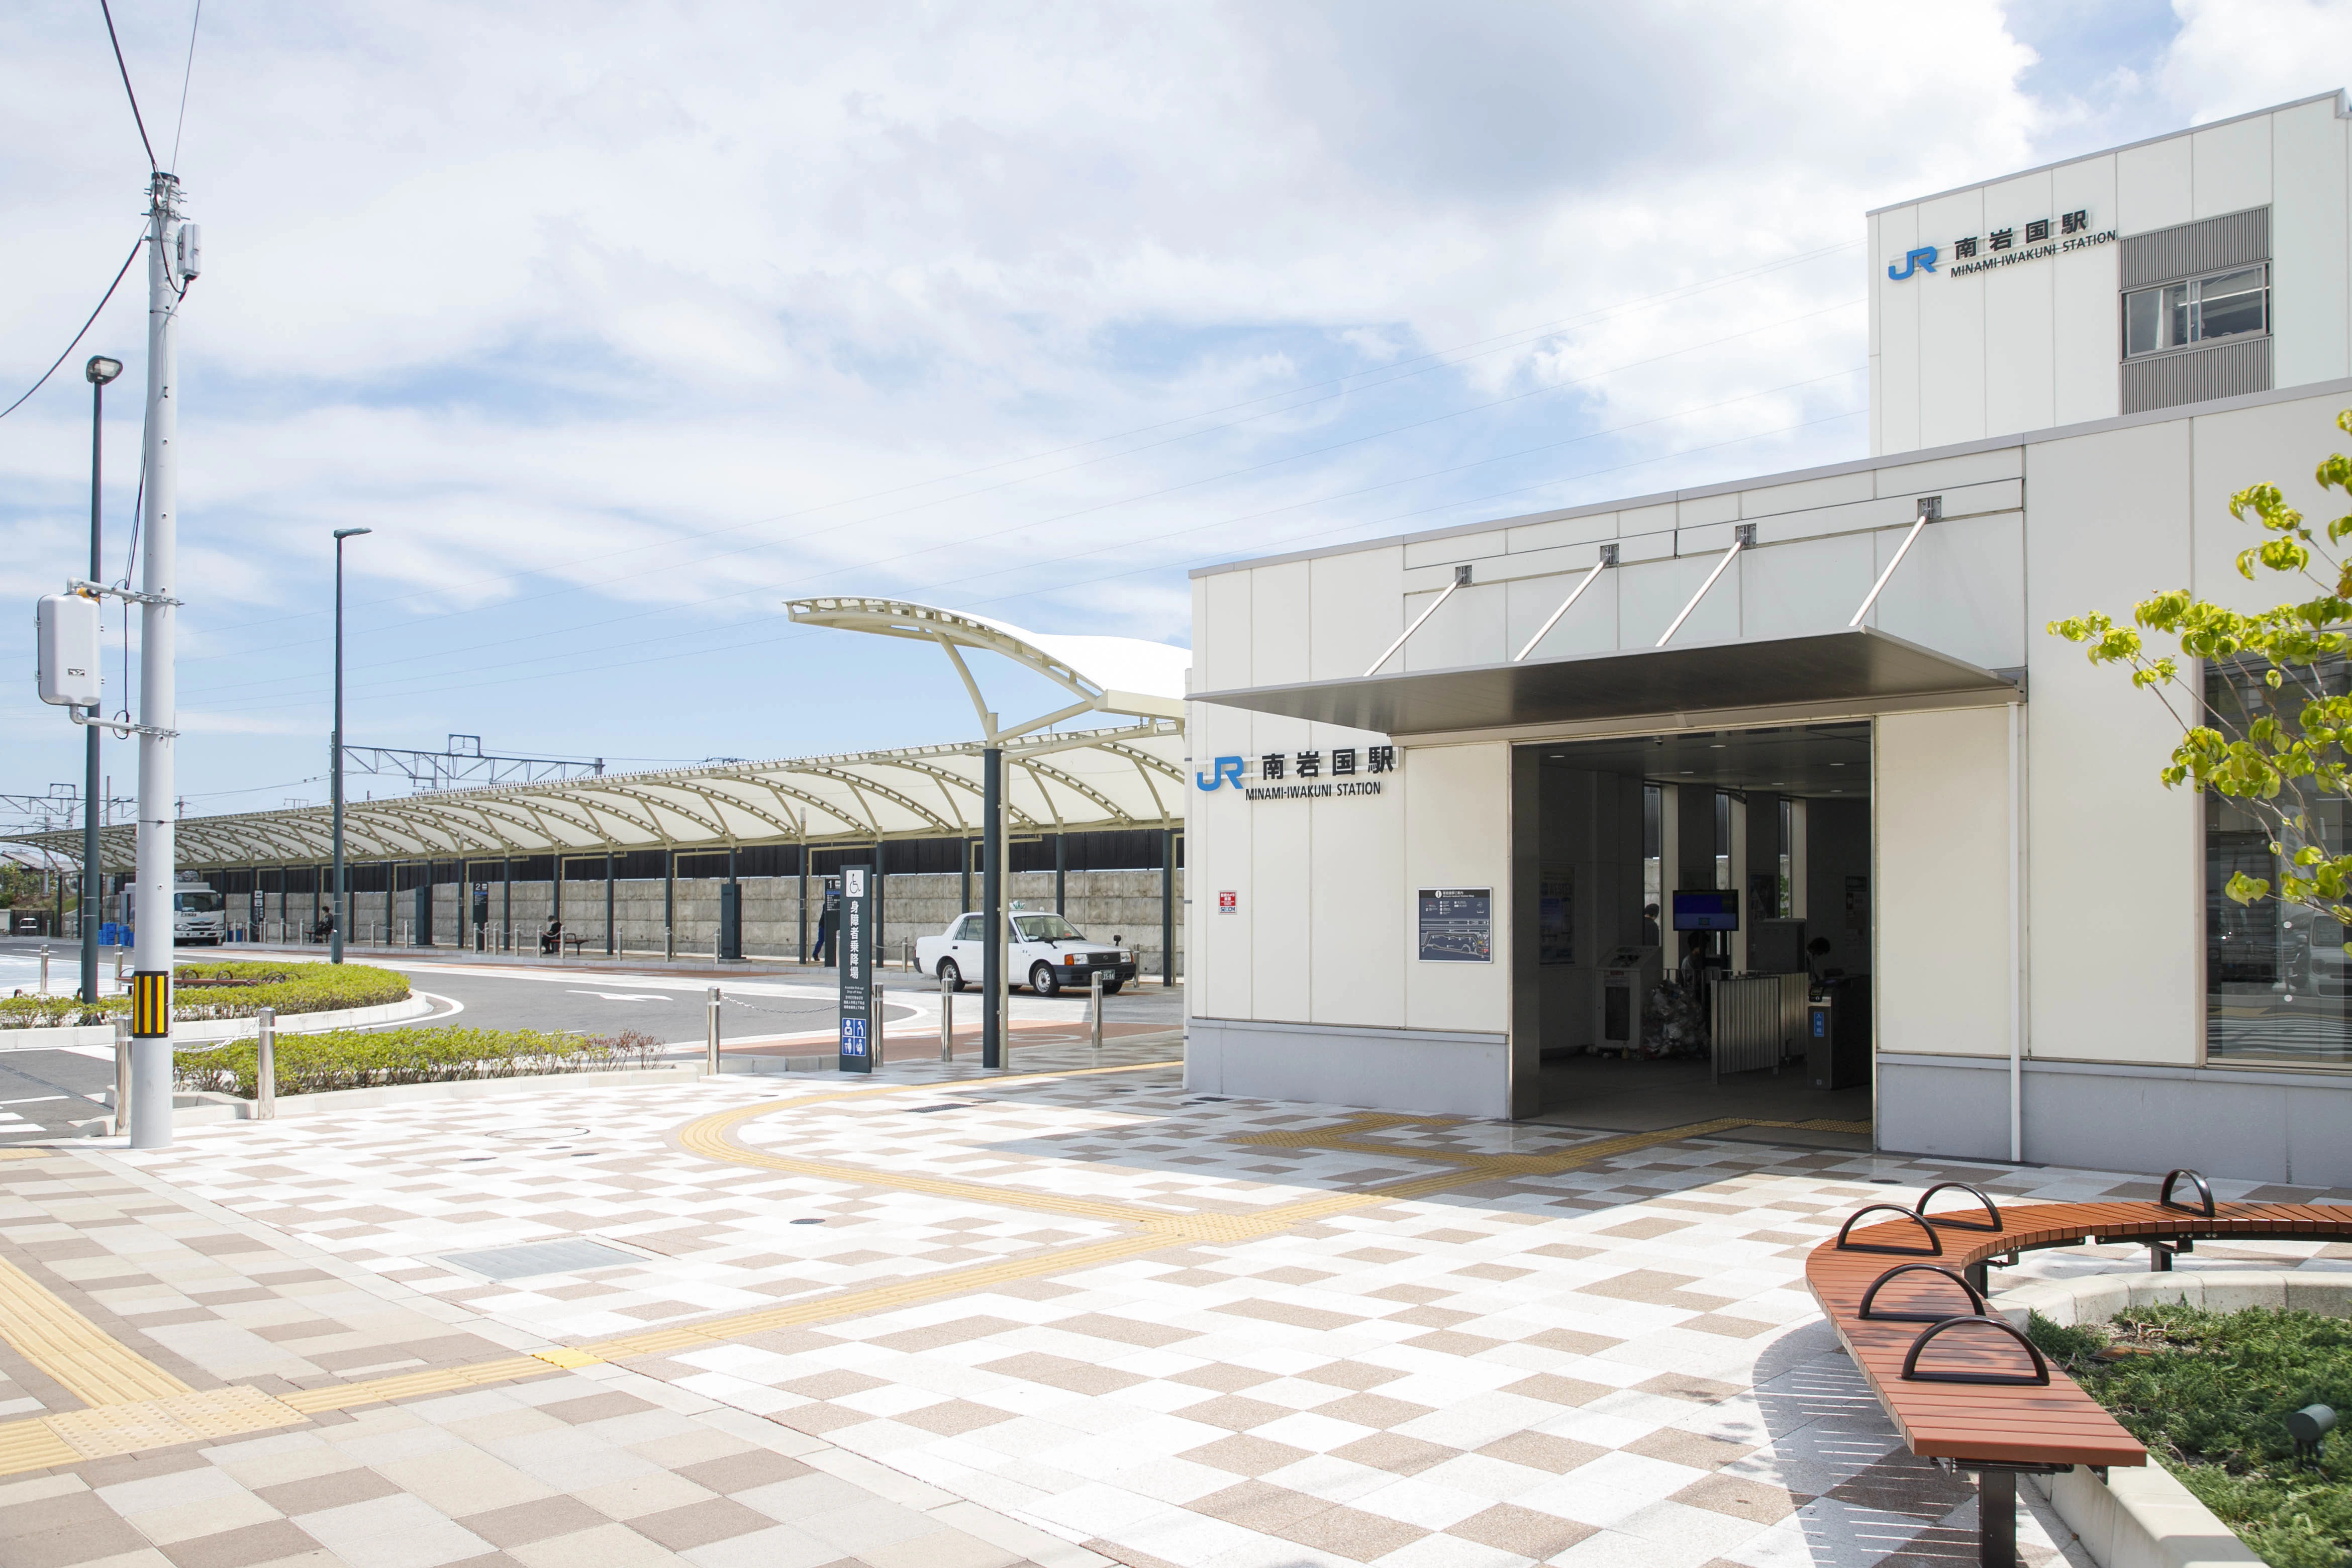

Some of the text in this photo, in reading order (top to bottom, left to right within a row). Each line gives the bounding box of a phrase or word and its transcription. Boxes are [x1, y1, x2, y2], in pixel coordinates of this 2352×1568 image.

[1954, 209, 2087, 260] 南岩国駅
[1888, 246, 1937, 280] JR
[1950, 230, 2116, 278] MINAMI-IWAKUNI STATION
[1197, 755, 1244, 791] JR
[1261, 745, 1394, 780] 南岩国駅
[1245, 781, 1381, 801] MINAMI-IWAKUNI STATION
[828, 880, 832, 889] 1
[849, 900, 859, 979] 身障者乗降場
